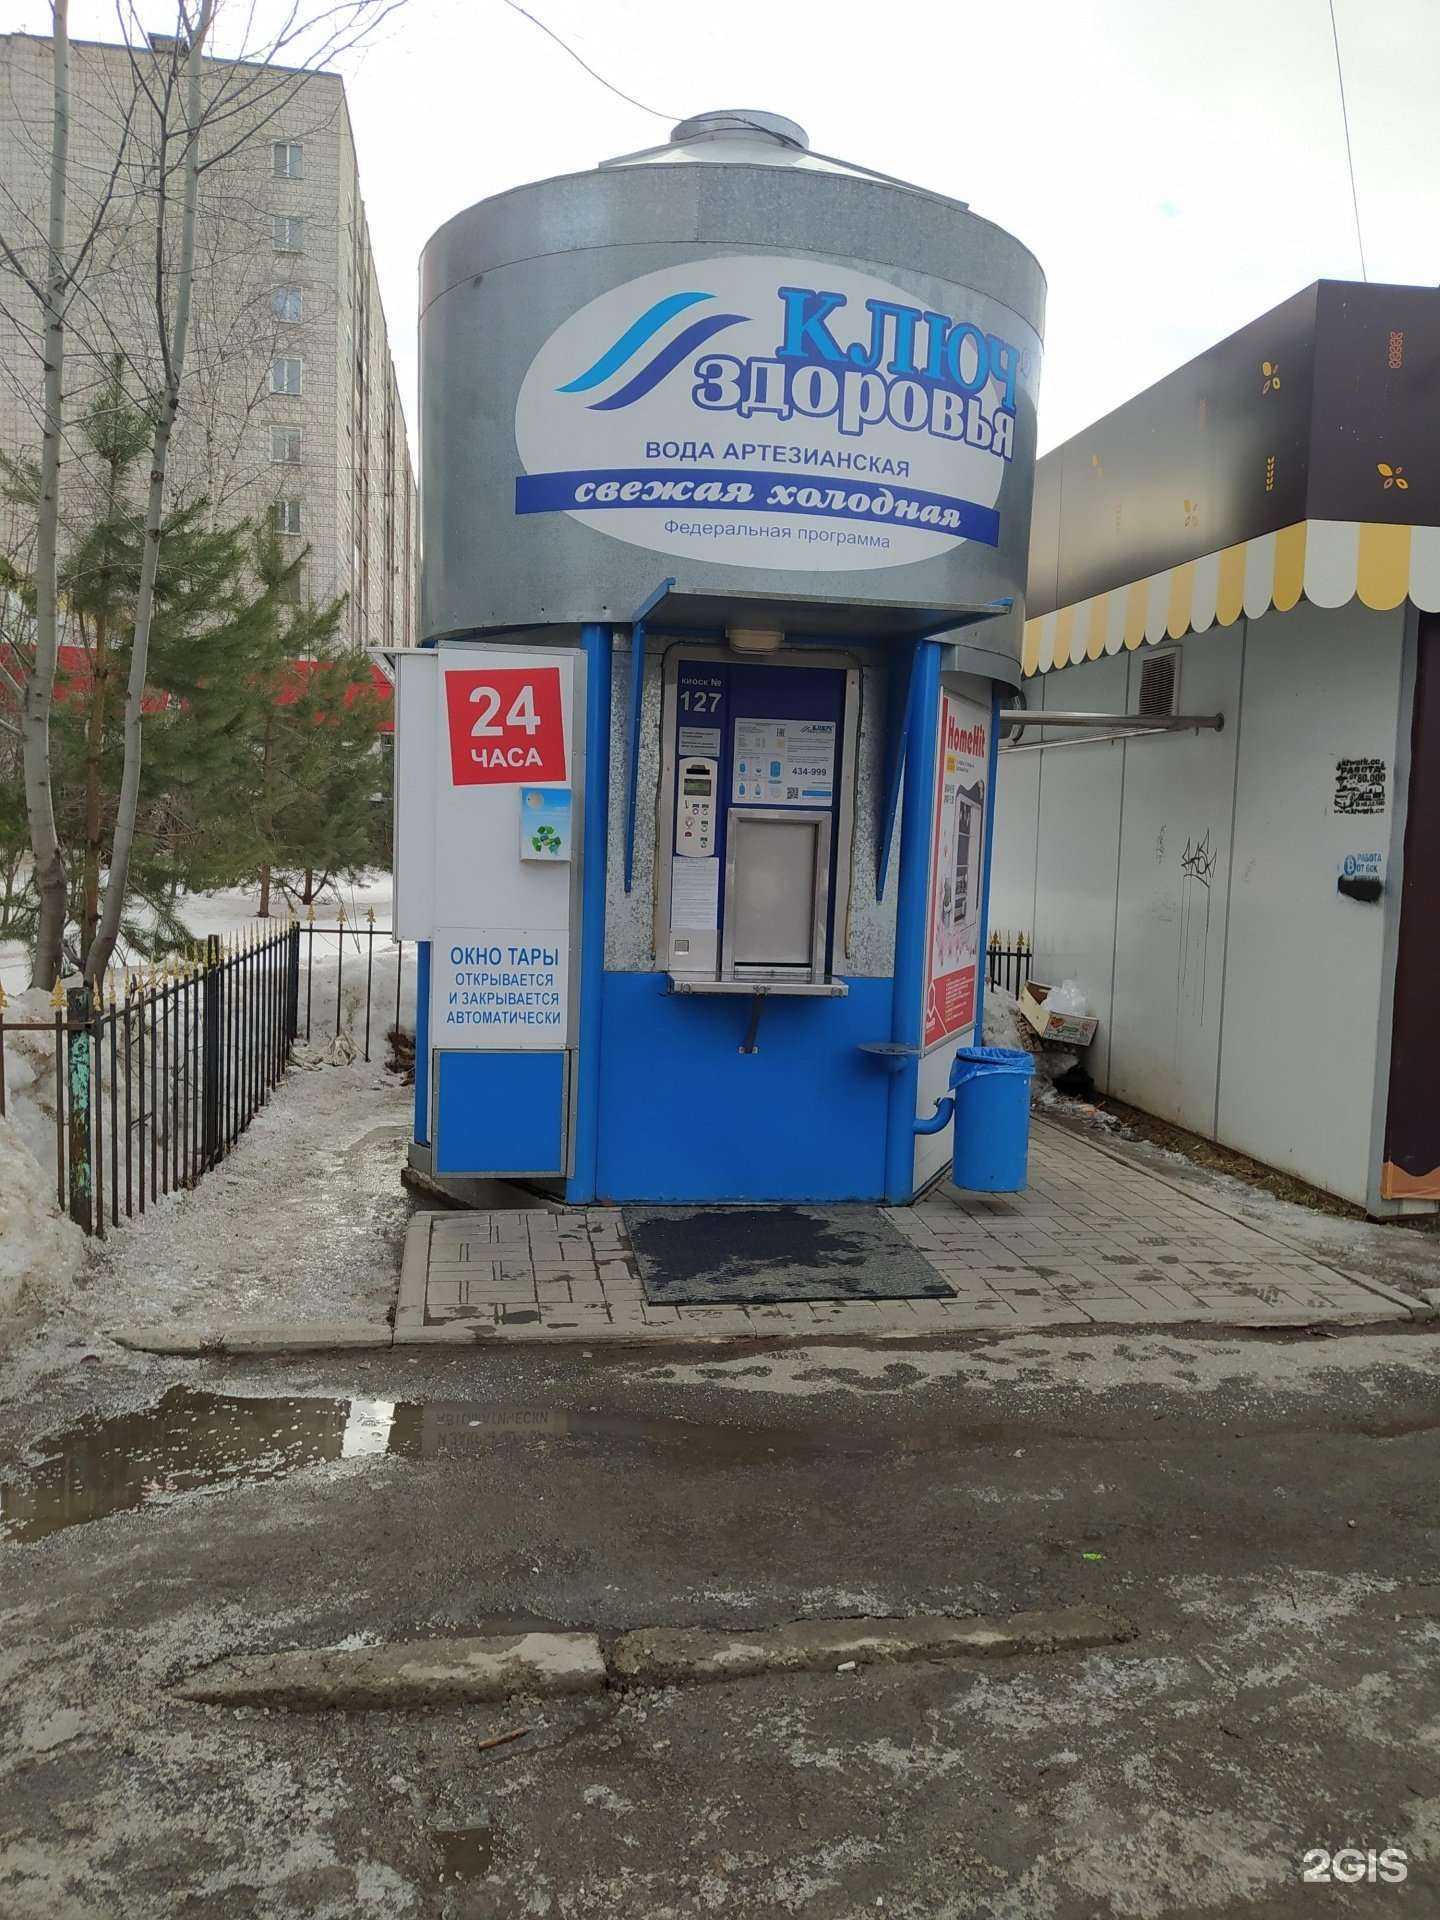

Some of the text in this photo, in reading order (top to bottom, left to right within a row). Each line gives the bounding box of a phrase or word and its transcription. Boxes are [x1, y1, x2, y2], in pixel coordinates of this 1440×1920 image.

[645, 441, 911, 478] ВОДА АРТЕЗИАНСКАЯ
[574, 478, 962, 529] свежая холодная
[664, 519, 891, 549] Федеральная программа
[469, 685, 541, 736] 24
[680, 690, 722, 712] 127
[471, 747, 544, 768] ЧАСА
[791, 767, 827, 776] 434-999
[450, 946, 559, 966] ОКНО ТАРЫ
[455, 972, 554, 987] ОТКРЫВАЕТСЯ
[449, 991, 559, 1006] И ЗАКРЫВАЕТСЯ
[446, 1010, 561, 1025] АВТОМАТИЧЕСКИ
